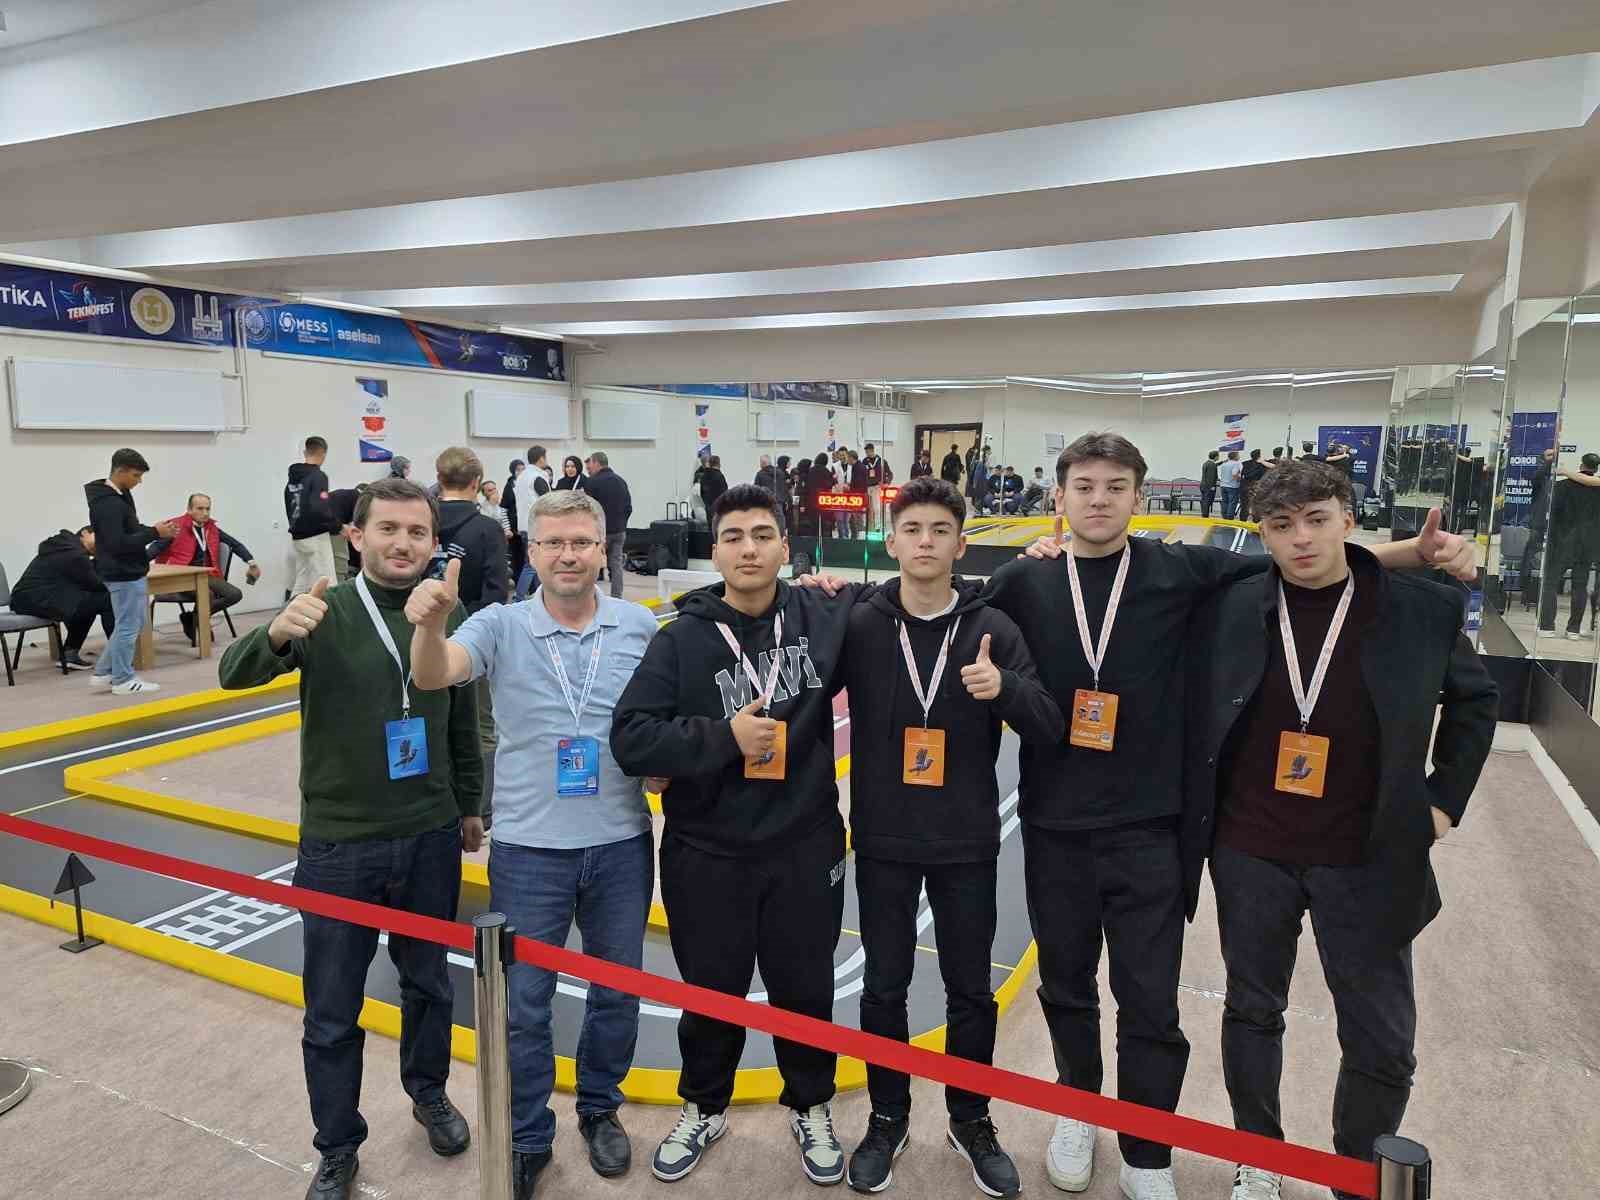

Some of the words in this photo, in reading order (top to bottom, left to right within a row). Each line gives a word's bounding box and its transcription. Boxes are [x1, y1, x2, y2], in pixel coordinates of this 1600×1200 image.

[0, 284, 47, 308] TİKA
[66, 302, 115, 320] TEKNOFEST
[296, 318, 329, 333] MESS
[337, 328, 381, 345] aselsan
